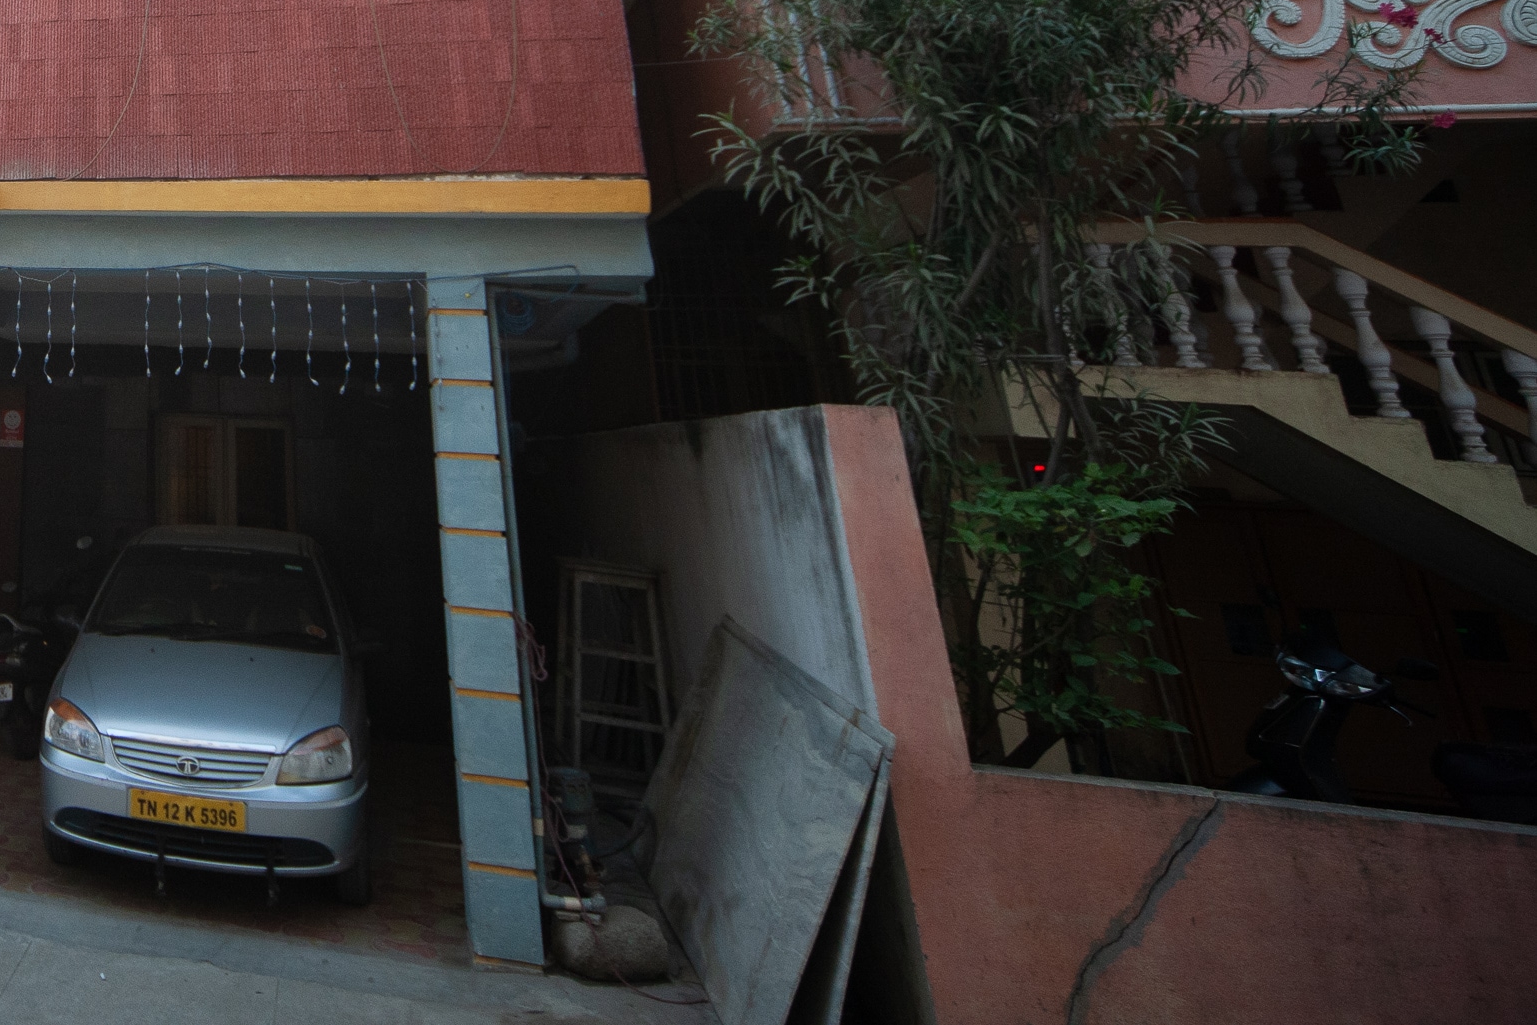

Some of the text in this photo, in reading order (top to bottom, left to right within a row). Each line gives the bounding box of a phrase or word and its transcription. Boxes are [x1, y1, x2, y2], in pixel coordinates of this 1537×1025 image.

[137, 798, 237, 827] TN 12 K 5396
